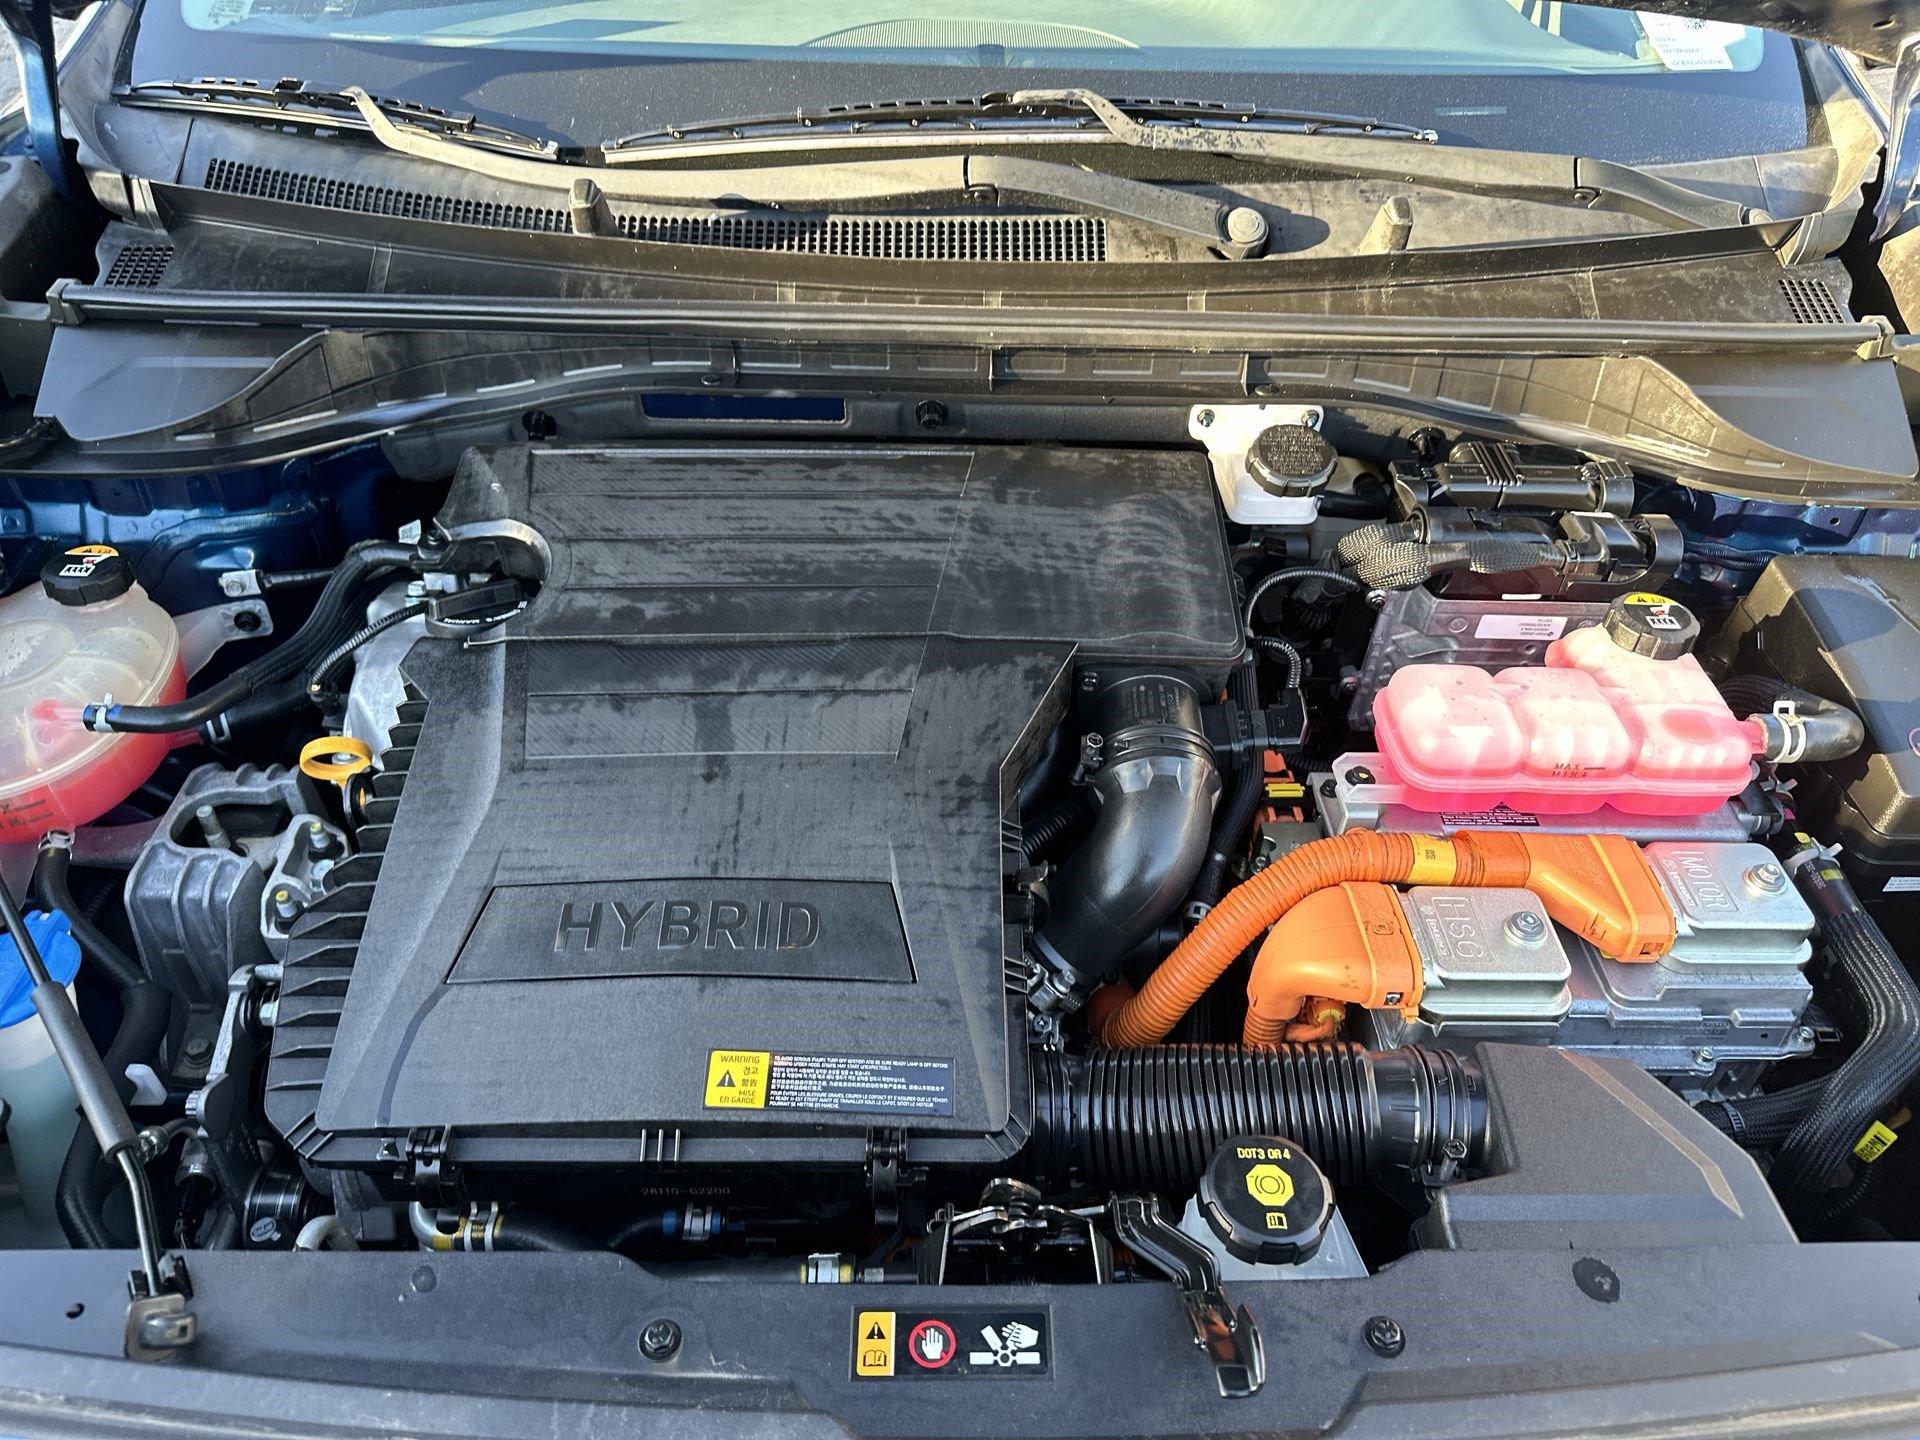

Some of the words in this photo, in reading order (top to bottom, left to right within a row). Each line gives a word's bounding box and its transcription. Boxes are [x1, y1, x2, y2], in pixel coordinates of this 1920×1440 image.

[1678, 856, 1730, 908] MOTOR
[554, 900, 820, 952] HYBRID
[1438, 903, 1484, 958] HSG
[720, 1055, 760, 1064] WARNING
[743, 1066, 758, 1076] 경고
[1236, 1148, 1266, 1160] DOT3
[1267, 1148, 1282, 1160] OR
[1282, 1148, 1291, 1160] 4
